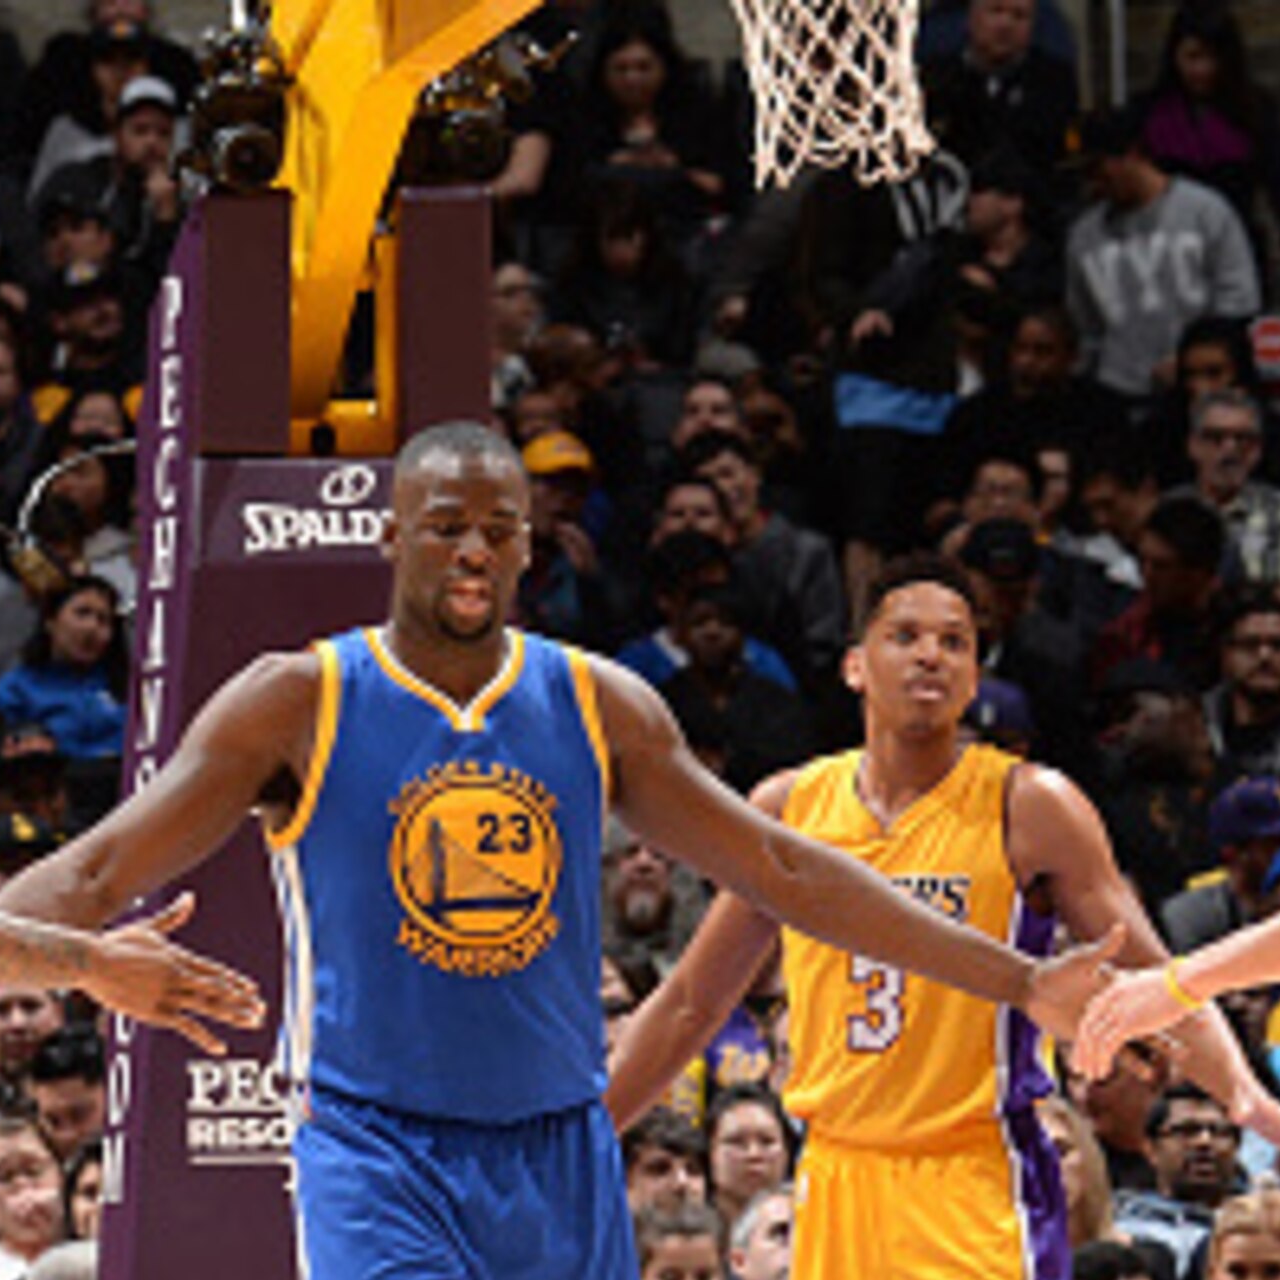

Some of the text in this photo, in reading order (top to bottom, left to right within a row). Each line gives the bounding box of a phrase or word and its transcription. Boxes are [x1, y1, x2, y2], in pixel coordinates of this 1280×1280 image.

[243, 503, 394, 554] SPALD
[477, 813, 533, 853] 23
[847, 955, 906, 1053] 3
[187, 1060, 294, 1112] PEC
[187, 1118, 296, 1147] RESO
